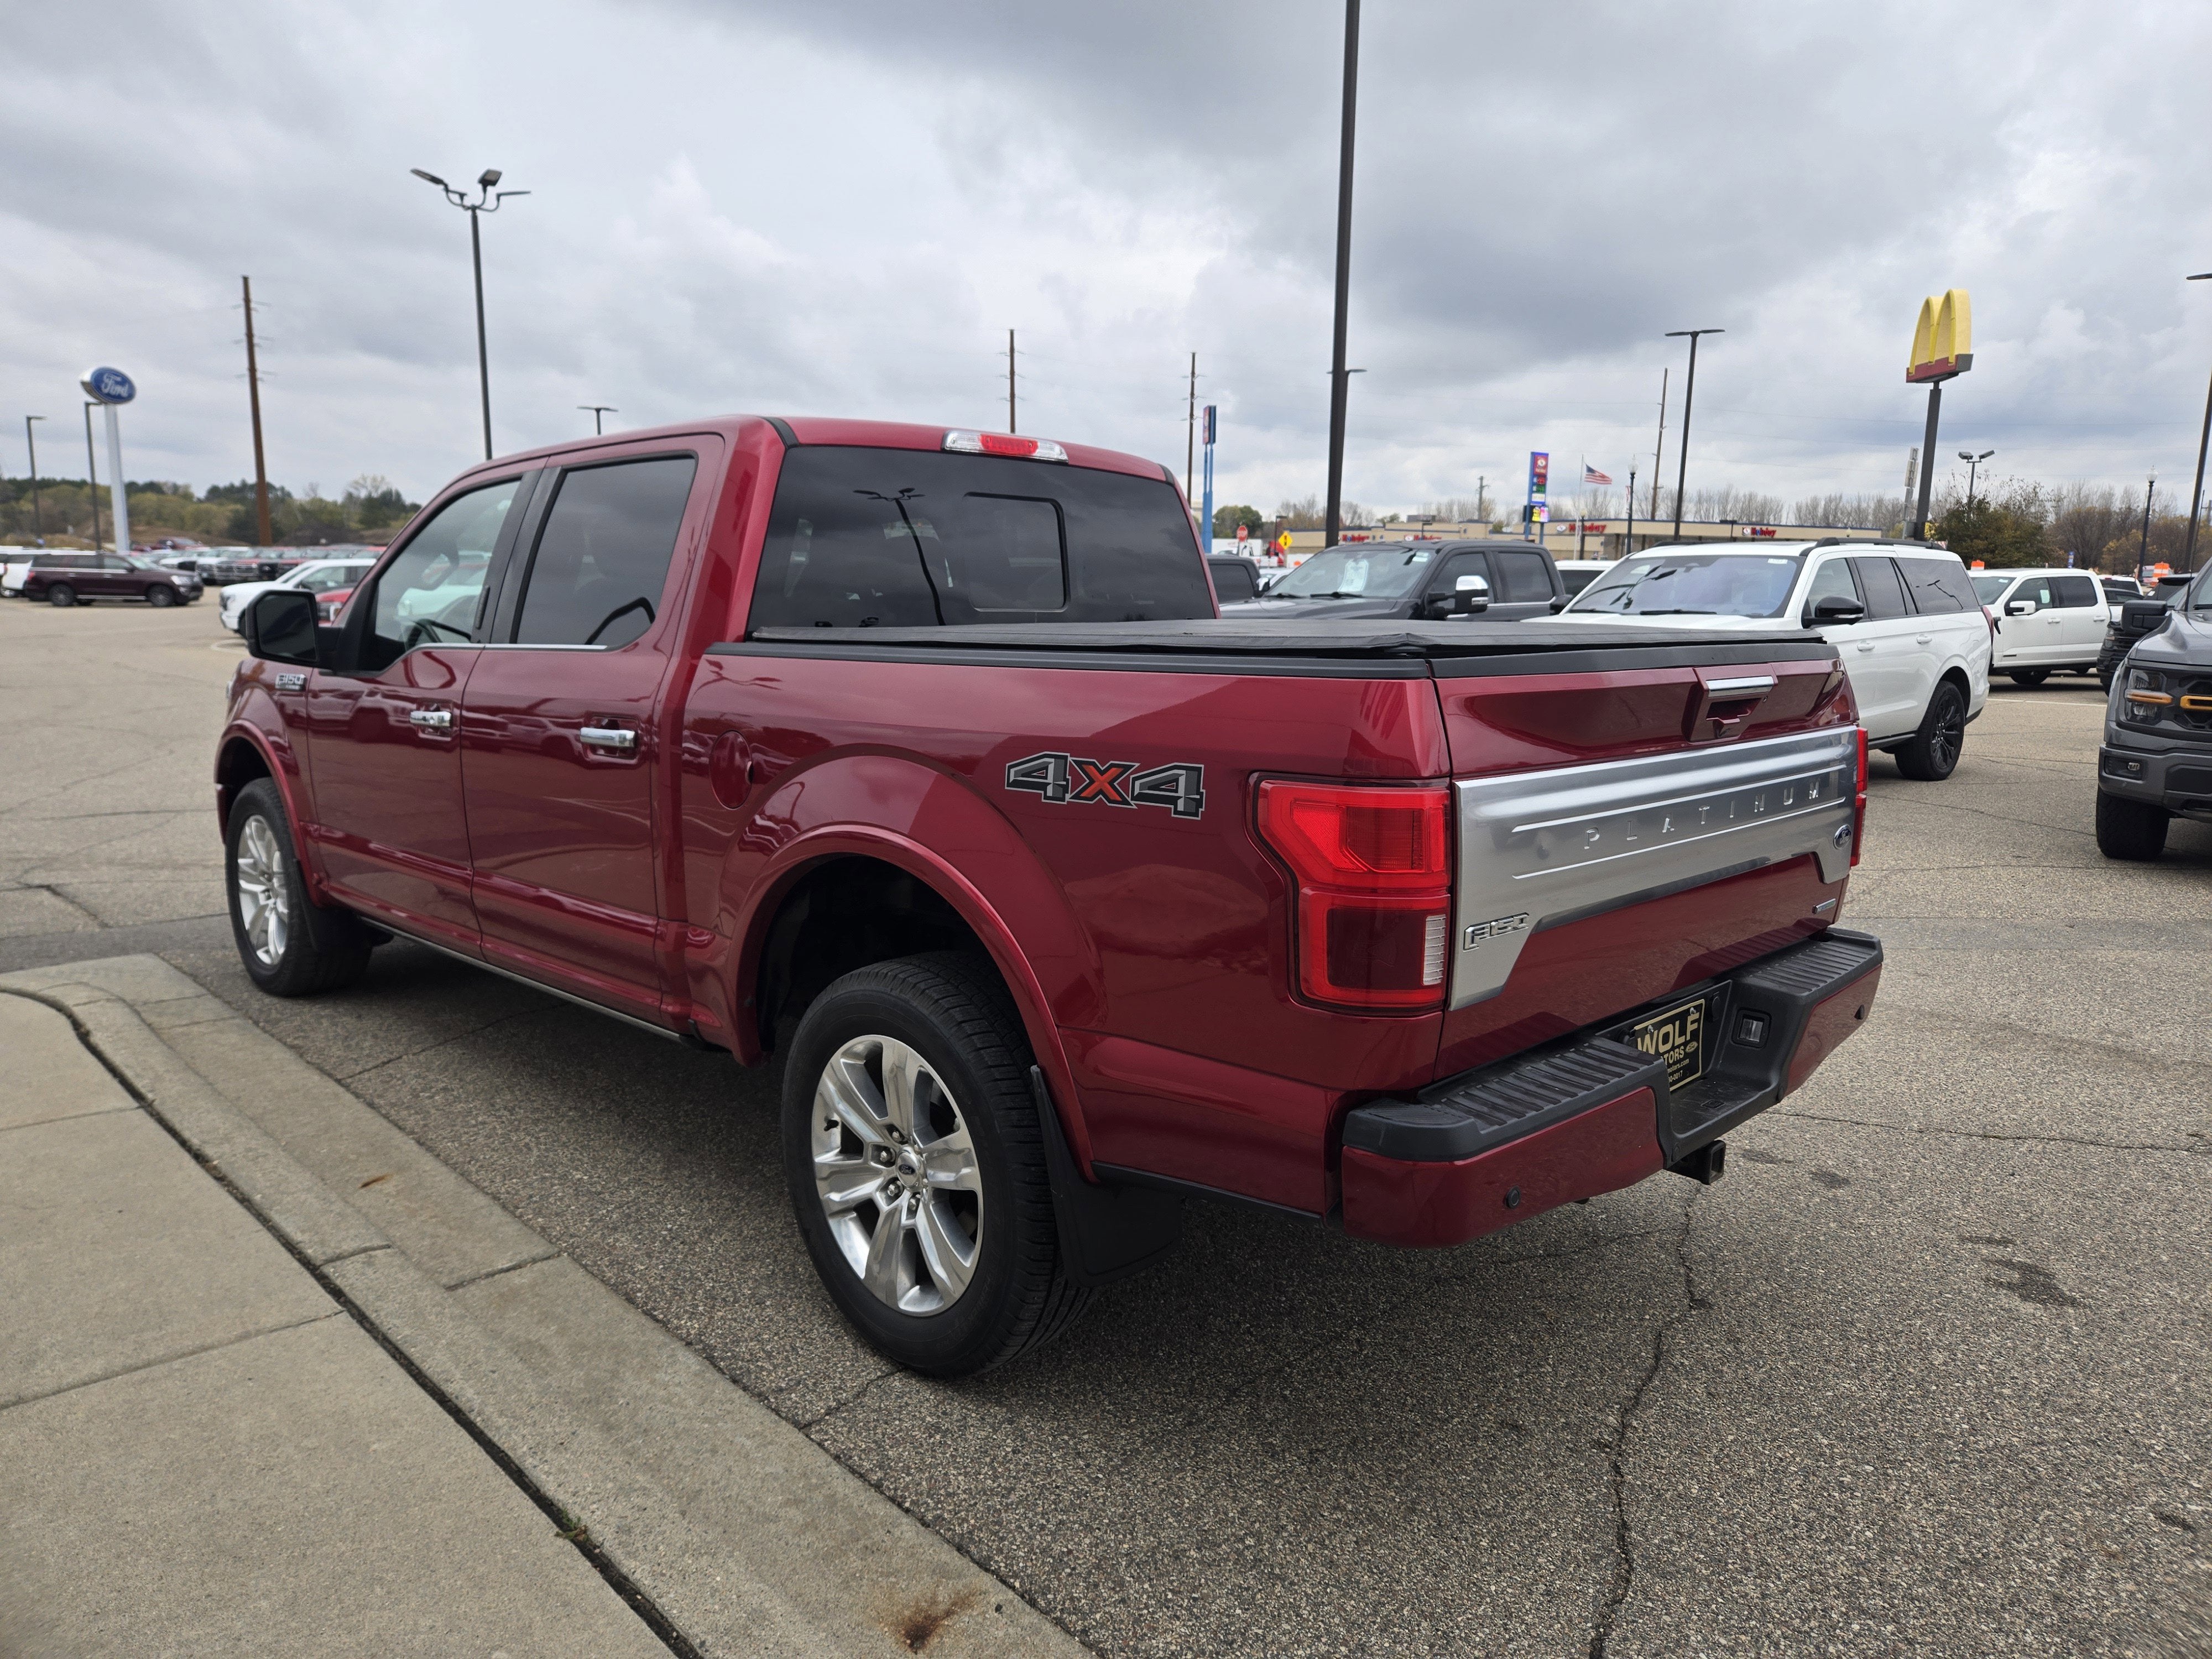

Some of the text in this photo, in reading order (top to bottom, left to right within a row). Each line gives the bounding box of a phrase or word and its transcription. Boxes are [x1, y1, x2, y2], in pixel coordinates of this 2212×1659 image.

[101, 373, 128, 397] Ford
[1584, 781, 1819, 849] PLATINUM
[1637, 1012, 1699, 1055] WOLF
[1662, 1046, 1684, 1066] TORS
[1667, 1058, 1689, 1073] motors.com
